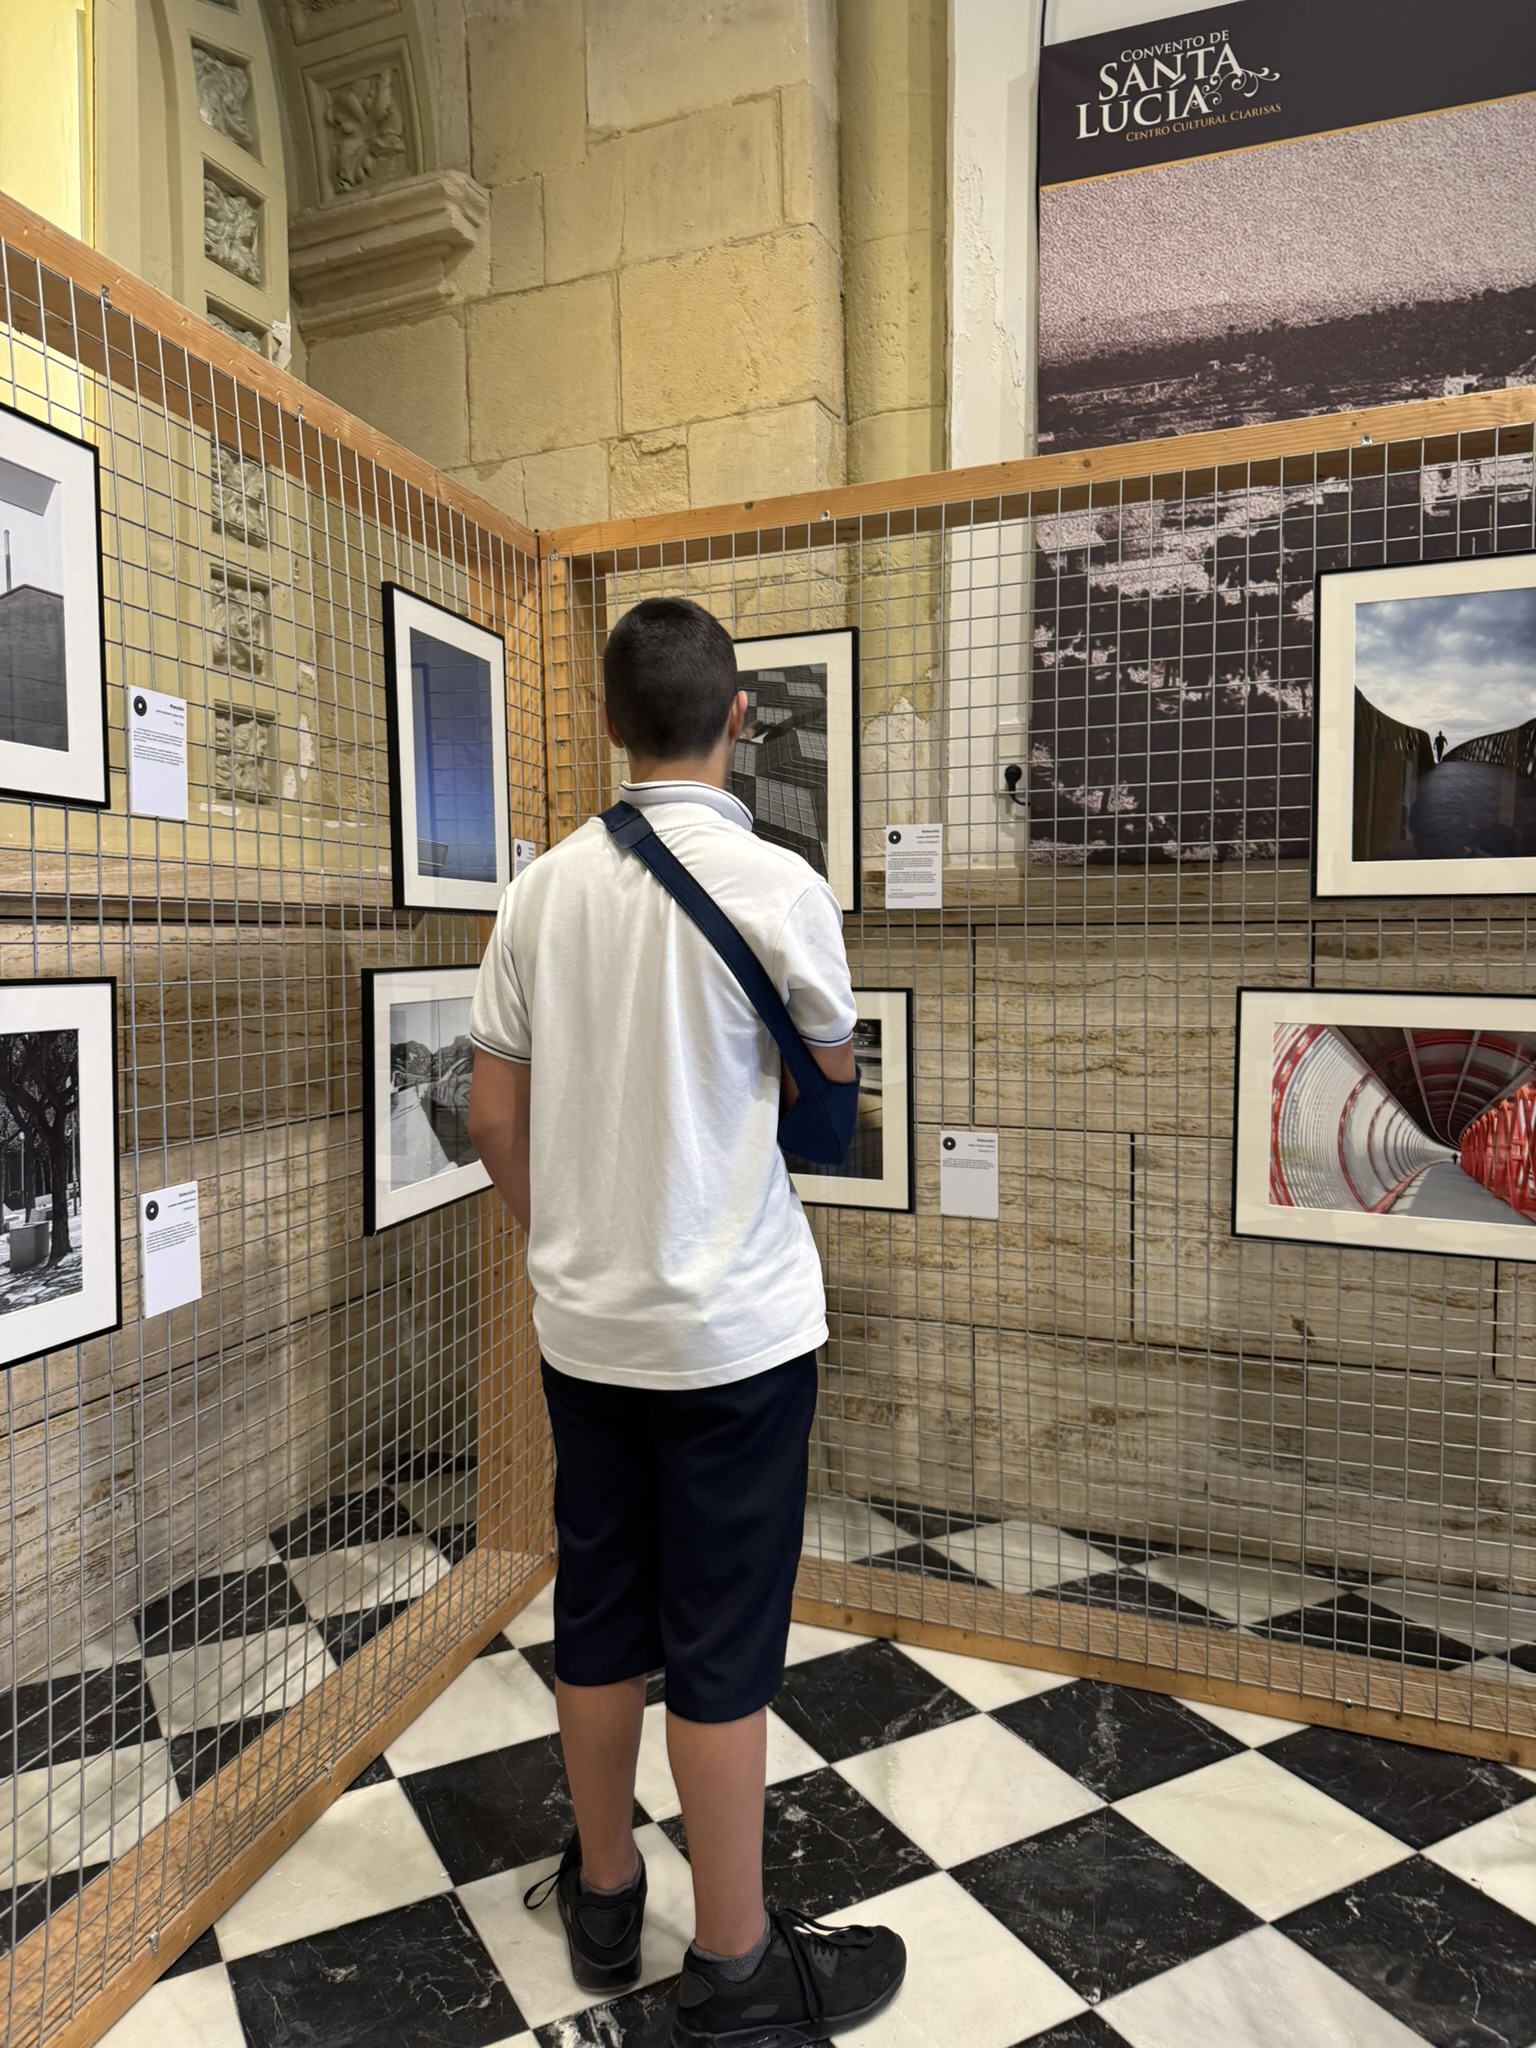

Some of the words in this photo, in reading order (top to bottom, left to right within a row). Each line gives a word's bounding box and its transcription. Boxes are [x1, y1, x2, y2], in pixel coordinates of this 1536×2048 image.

[1120, 35, 1205, 63] CONVENTO
[1210, 29, 1230, 44] DE
[1098, 42, 1242, 101] SANTA
[1075, 73, 1213, 140] LUCÍA
[1126, 126, 1170, 142] CENTRO
[1172, 114, 1228, 133] CULTURAL
[1230, 103, 1282, 121] CLARISAS
